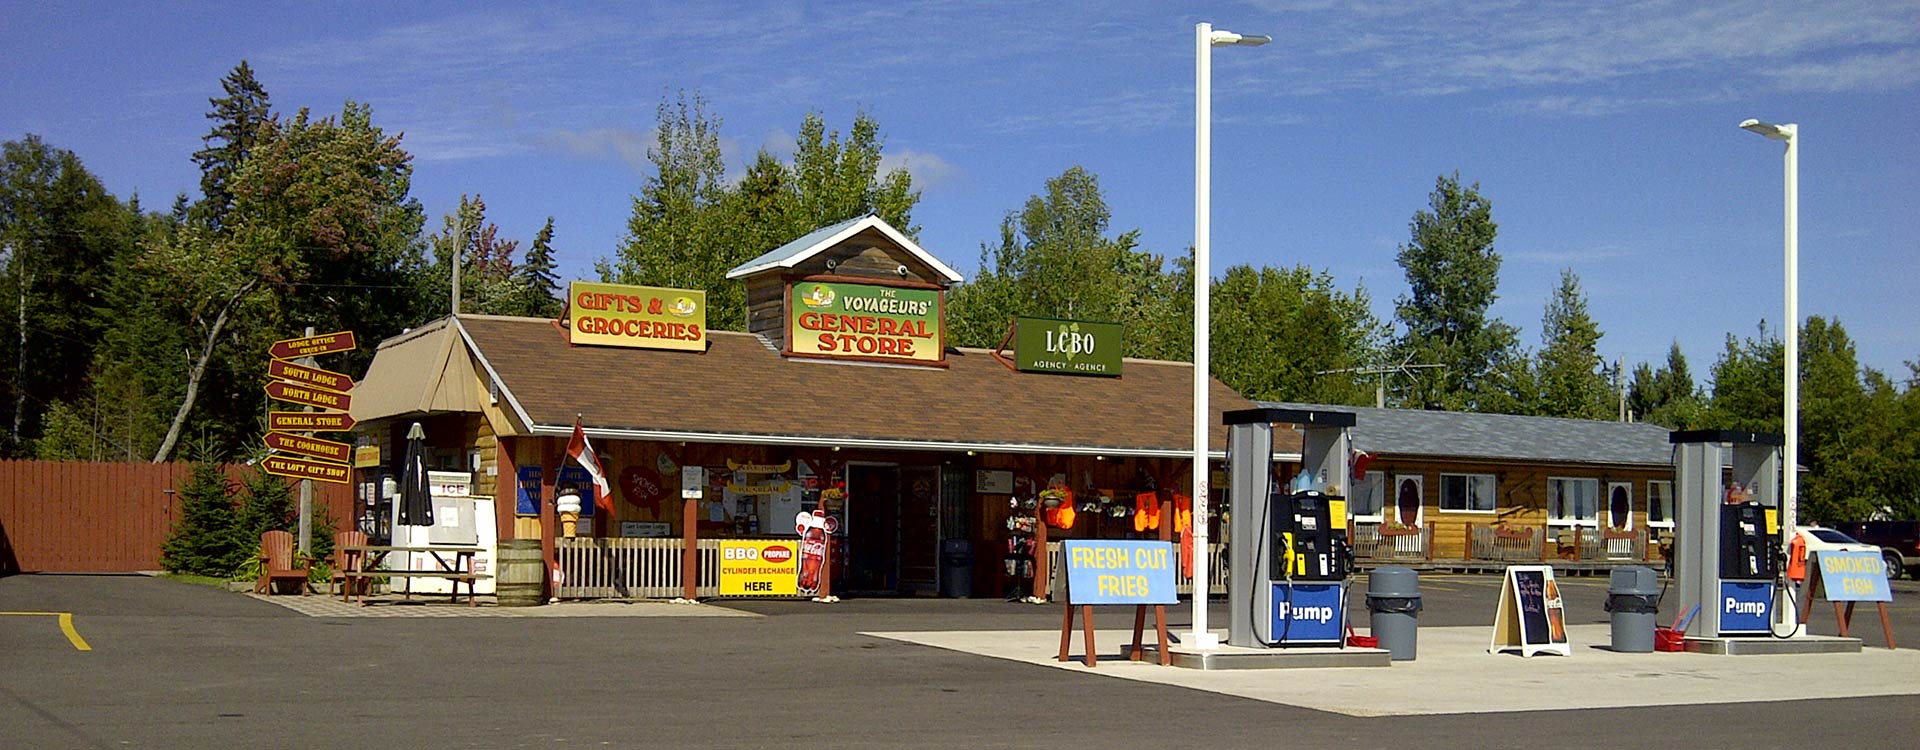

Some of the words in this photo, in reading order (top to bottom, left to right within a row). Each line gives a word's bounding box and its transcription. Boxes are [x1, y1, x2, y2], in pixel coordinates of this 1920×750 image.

[880, 289, 896, 298] THE
[577, 292, 643, 313] GIFTS
[648, 297, 663, 315] &
[843, 296, 932, 316] VOYAGEURS'
[577, 317, 701, 341] GROCERIES
[799, 312, 934, 339] GENERAL
[288, 340, 310, 349] LODGE
[311, 336, 335, 346] OFFICE
[818, 333, 916, 356] STORE
[1046, 330, 1095, 355] LCBO
[1033, 361, 1067, 369] AGENCY
[1074, 363, 1106, 371] AGENCE
[283, 366, 310, 380] SOUTH
[312, 373, 338, 386] LODGE
[282, 387, 310, 400] NORTH
[312, 393, 338, 405] LODGE
[276, 417, 314, 426] GENERAL
[316, 417, 342, 426] STORE
[279, 437, 295, 448] THE
[296, 440, 340, 456] COOKHOUSE
[270, 461, 285, 469] THE
[287, 463, 306, 472] LOFT
[307, 465, 325, 475] GIFT
[326, 468, 345, 478] SHOP
[442, 484, 465, 494] ICE
[724, 547, 758, 560] BBQ
[763, 550, 790, 559] PROPANE
[1071, 547, 1130, 570] FRESH
[1135, 548, 1168, 570] CUT
[722, 567, 757, 575] CYLINDER
[758, 567, 795, 575] EXCHANGE
[1824, 556, 1881, 575] SMOKED
[744, 582, 773, 591] HERE
[1097, 575, 1149, 597] FRIES
[1843, 577, 1876, 596] FISH
[1279, 601, 1333, 625] Pump
[1725, 597, 1766, 617] Pump
